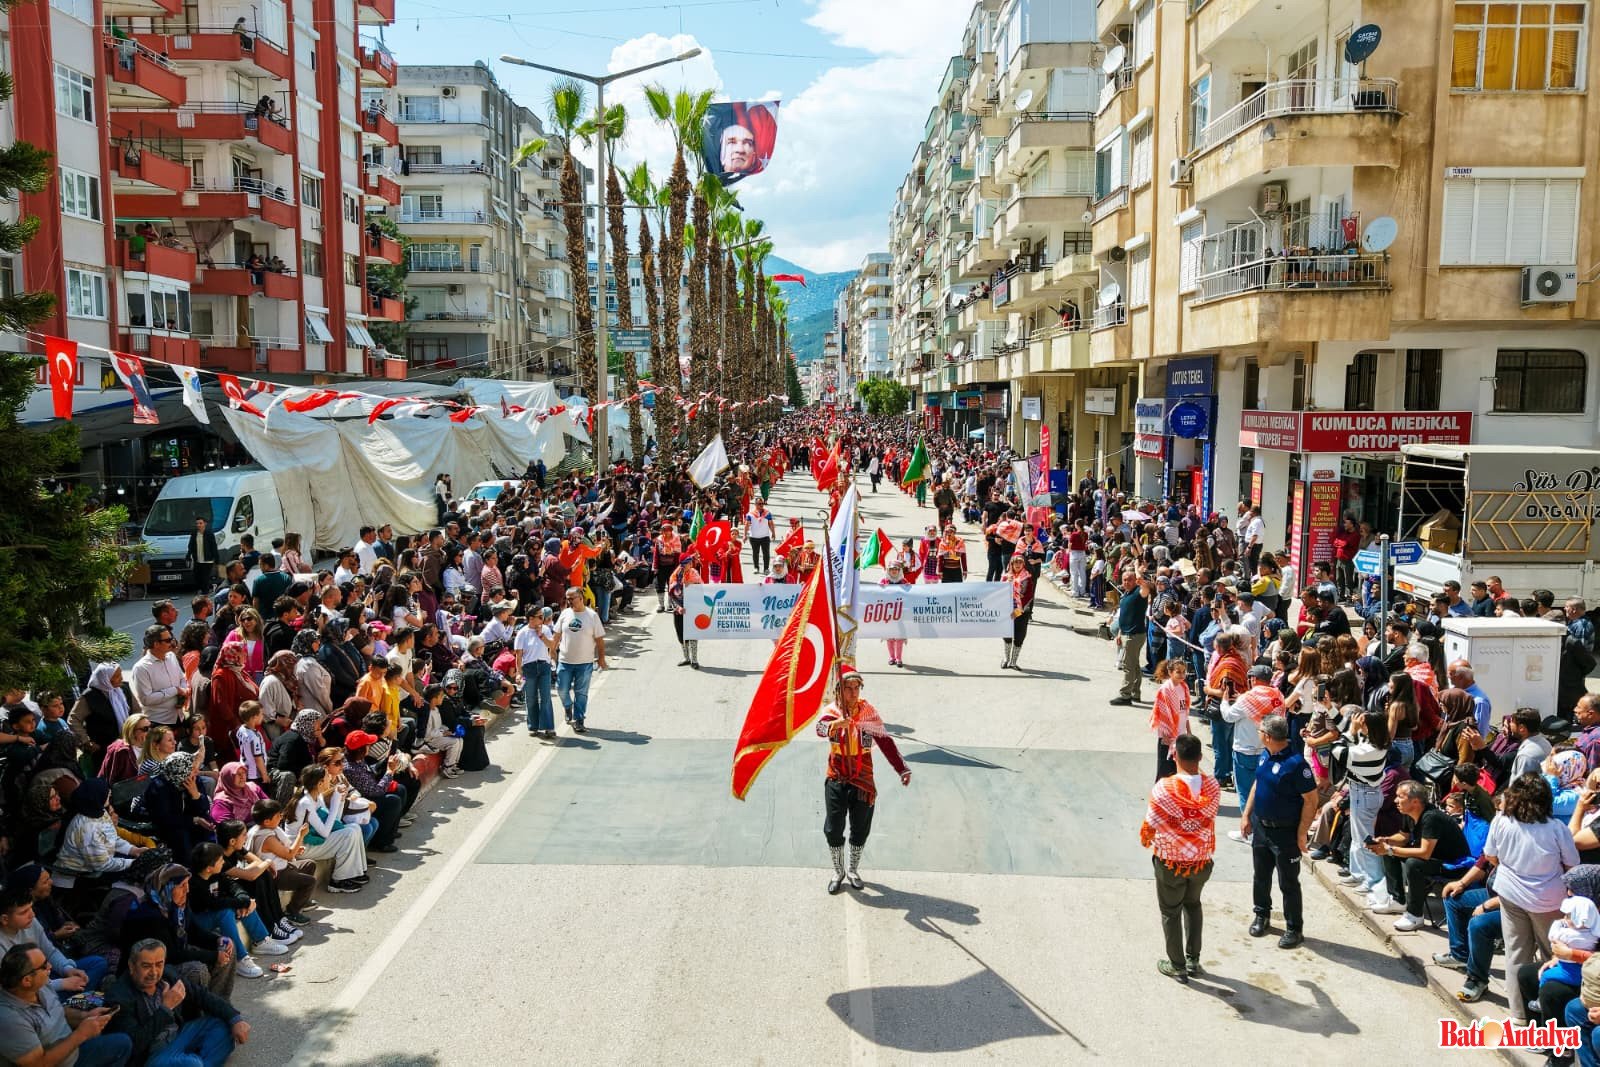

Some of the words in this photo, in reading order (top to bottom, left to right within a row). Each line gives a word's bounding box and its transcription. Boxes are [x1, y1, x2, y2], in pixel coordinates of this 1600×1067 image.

[1172, 371, 1187, 384] LOTUS
[1188, 369, 1203, 384] TEKEL
[1244, 415, 1268, 428] KUMLUCA
[1312, 416, 1386, 431] KUMLUCA
[1513, 469, 1561, 496] Süs
[926, 597, 940, 605] T.C.
[717, 607, 750, 615] KUMLUCA
[863, 598, 904, 624] GÖÇÜ
[913, 606, 953, 615] KUMLUCA
